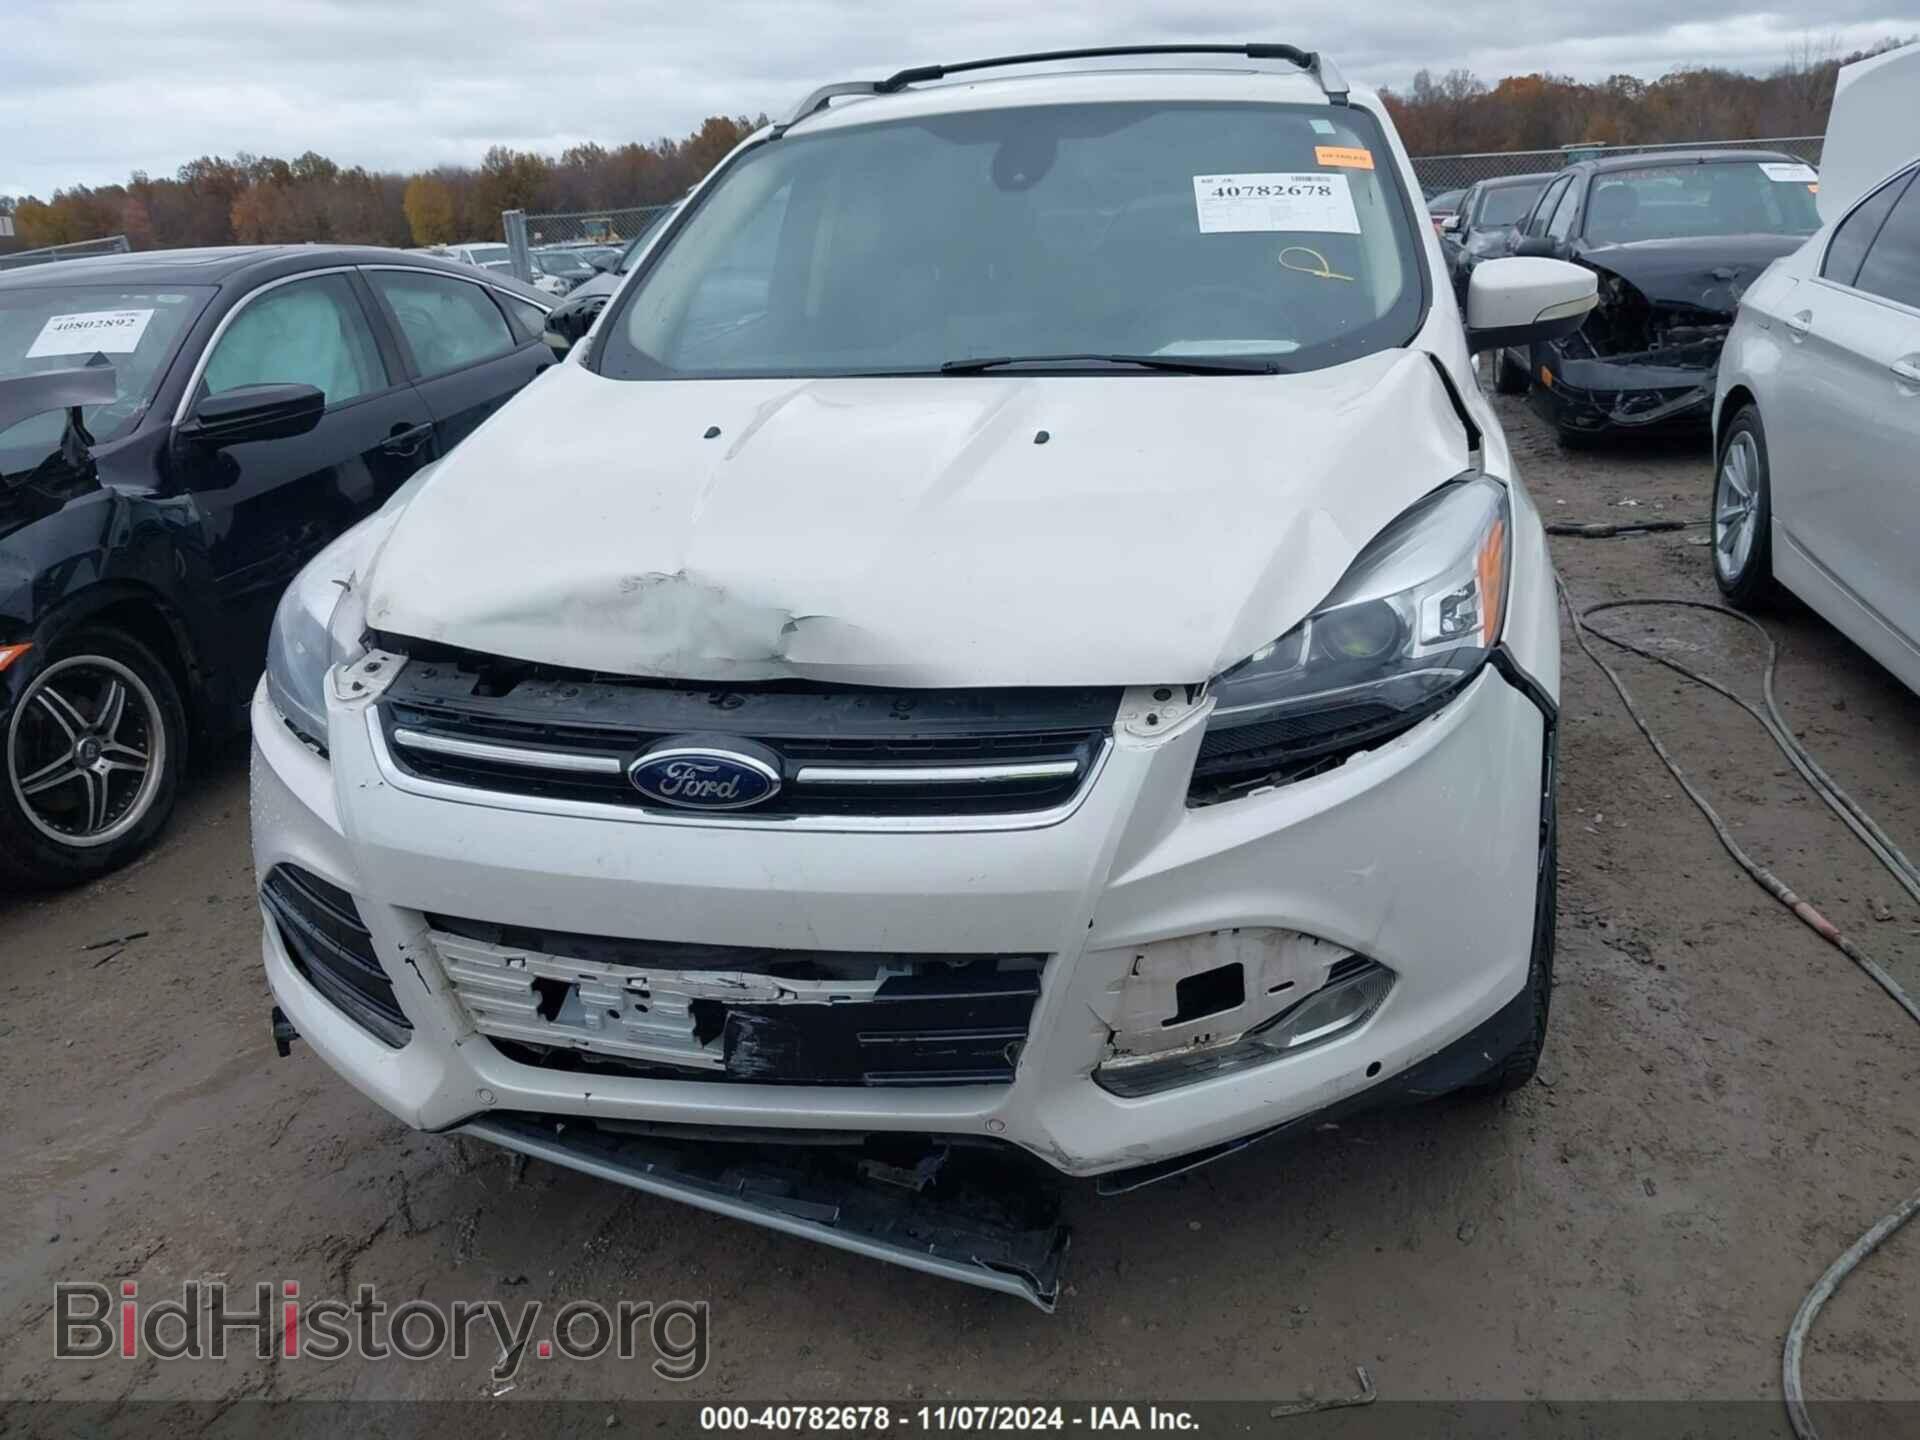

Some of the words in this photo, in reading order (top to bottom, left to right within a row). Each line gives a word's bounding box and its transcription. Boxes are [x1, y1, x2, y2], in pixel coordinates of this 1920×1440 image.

[1211, 185, 1332, 198] 40782678
[54, 318, 135, 331] 40802892
[659, 761, 740, 798] Ford
